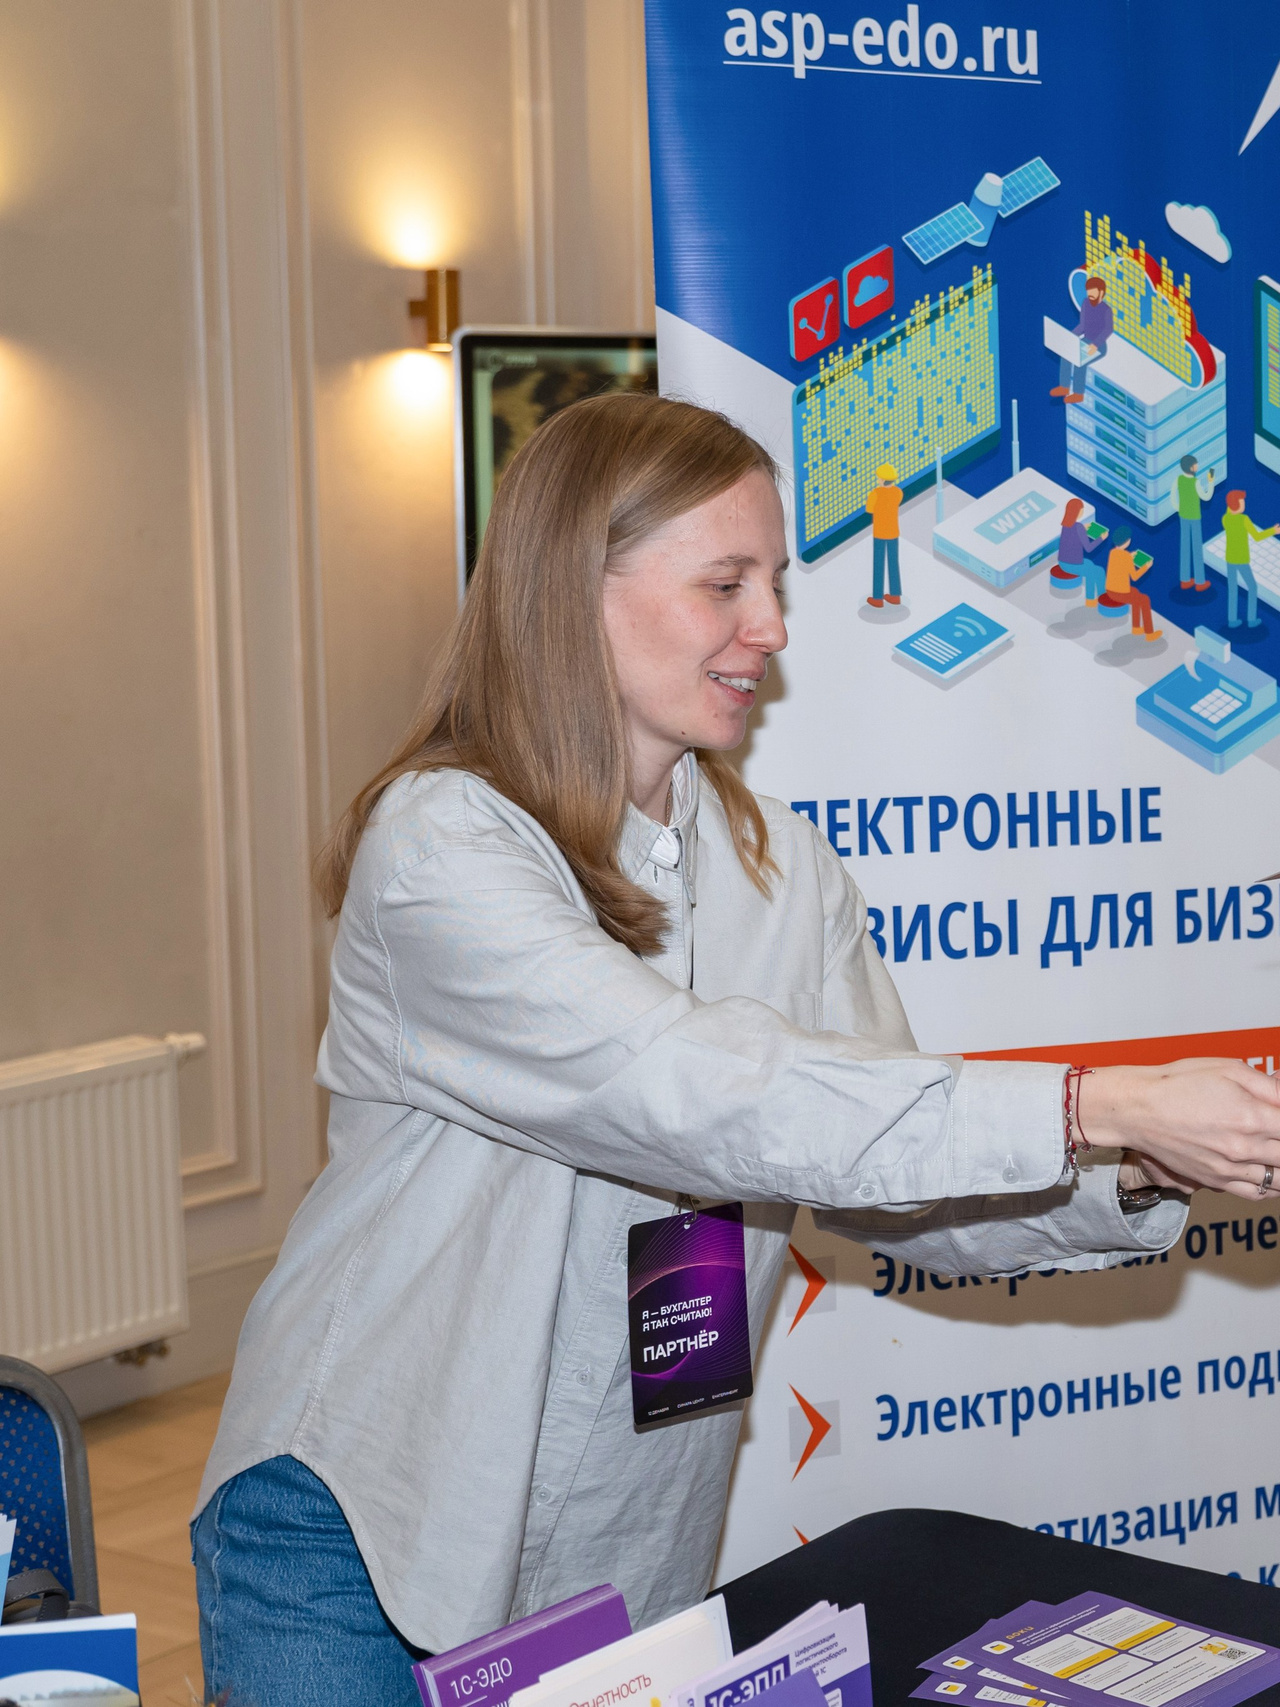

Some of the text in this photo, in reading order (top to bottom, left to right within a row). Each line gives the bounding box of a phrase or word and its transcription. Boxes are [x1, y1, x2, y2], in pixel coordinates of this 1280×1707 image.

[723, 3, 1040, 80] asp-edo.ru
[990, 499, 1041, 535] WIFI
[790, 787, 1162, 858] ЕКТРОННЫЕ
[1040, 891, 1153, 969] ДЛЯ
[650, 1317, 669, 1330] ТАК
[670, 1307, 713, 1325] СЧИТАЮ!
[660, 1295, 712, 1316] БУХГАЛТЕР
[643, 1330, 719, 1363] ПАРТНЁР
[876, 1365, 1182, 1441] Электронные
[450, 1657, 513, 1699] 1С-ЭДО
